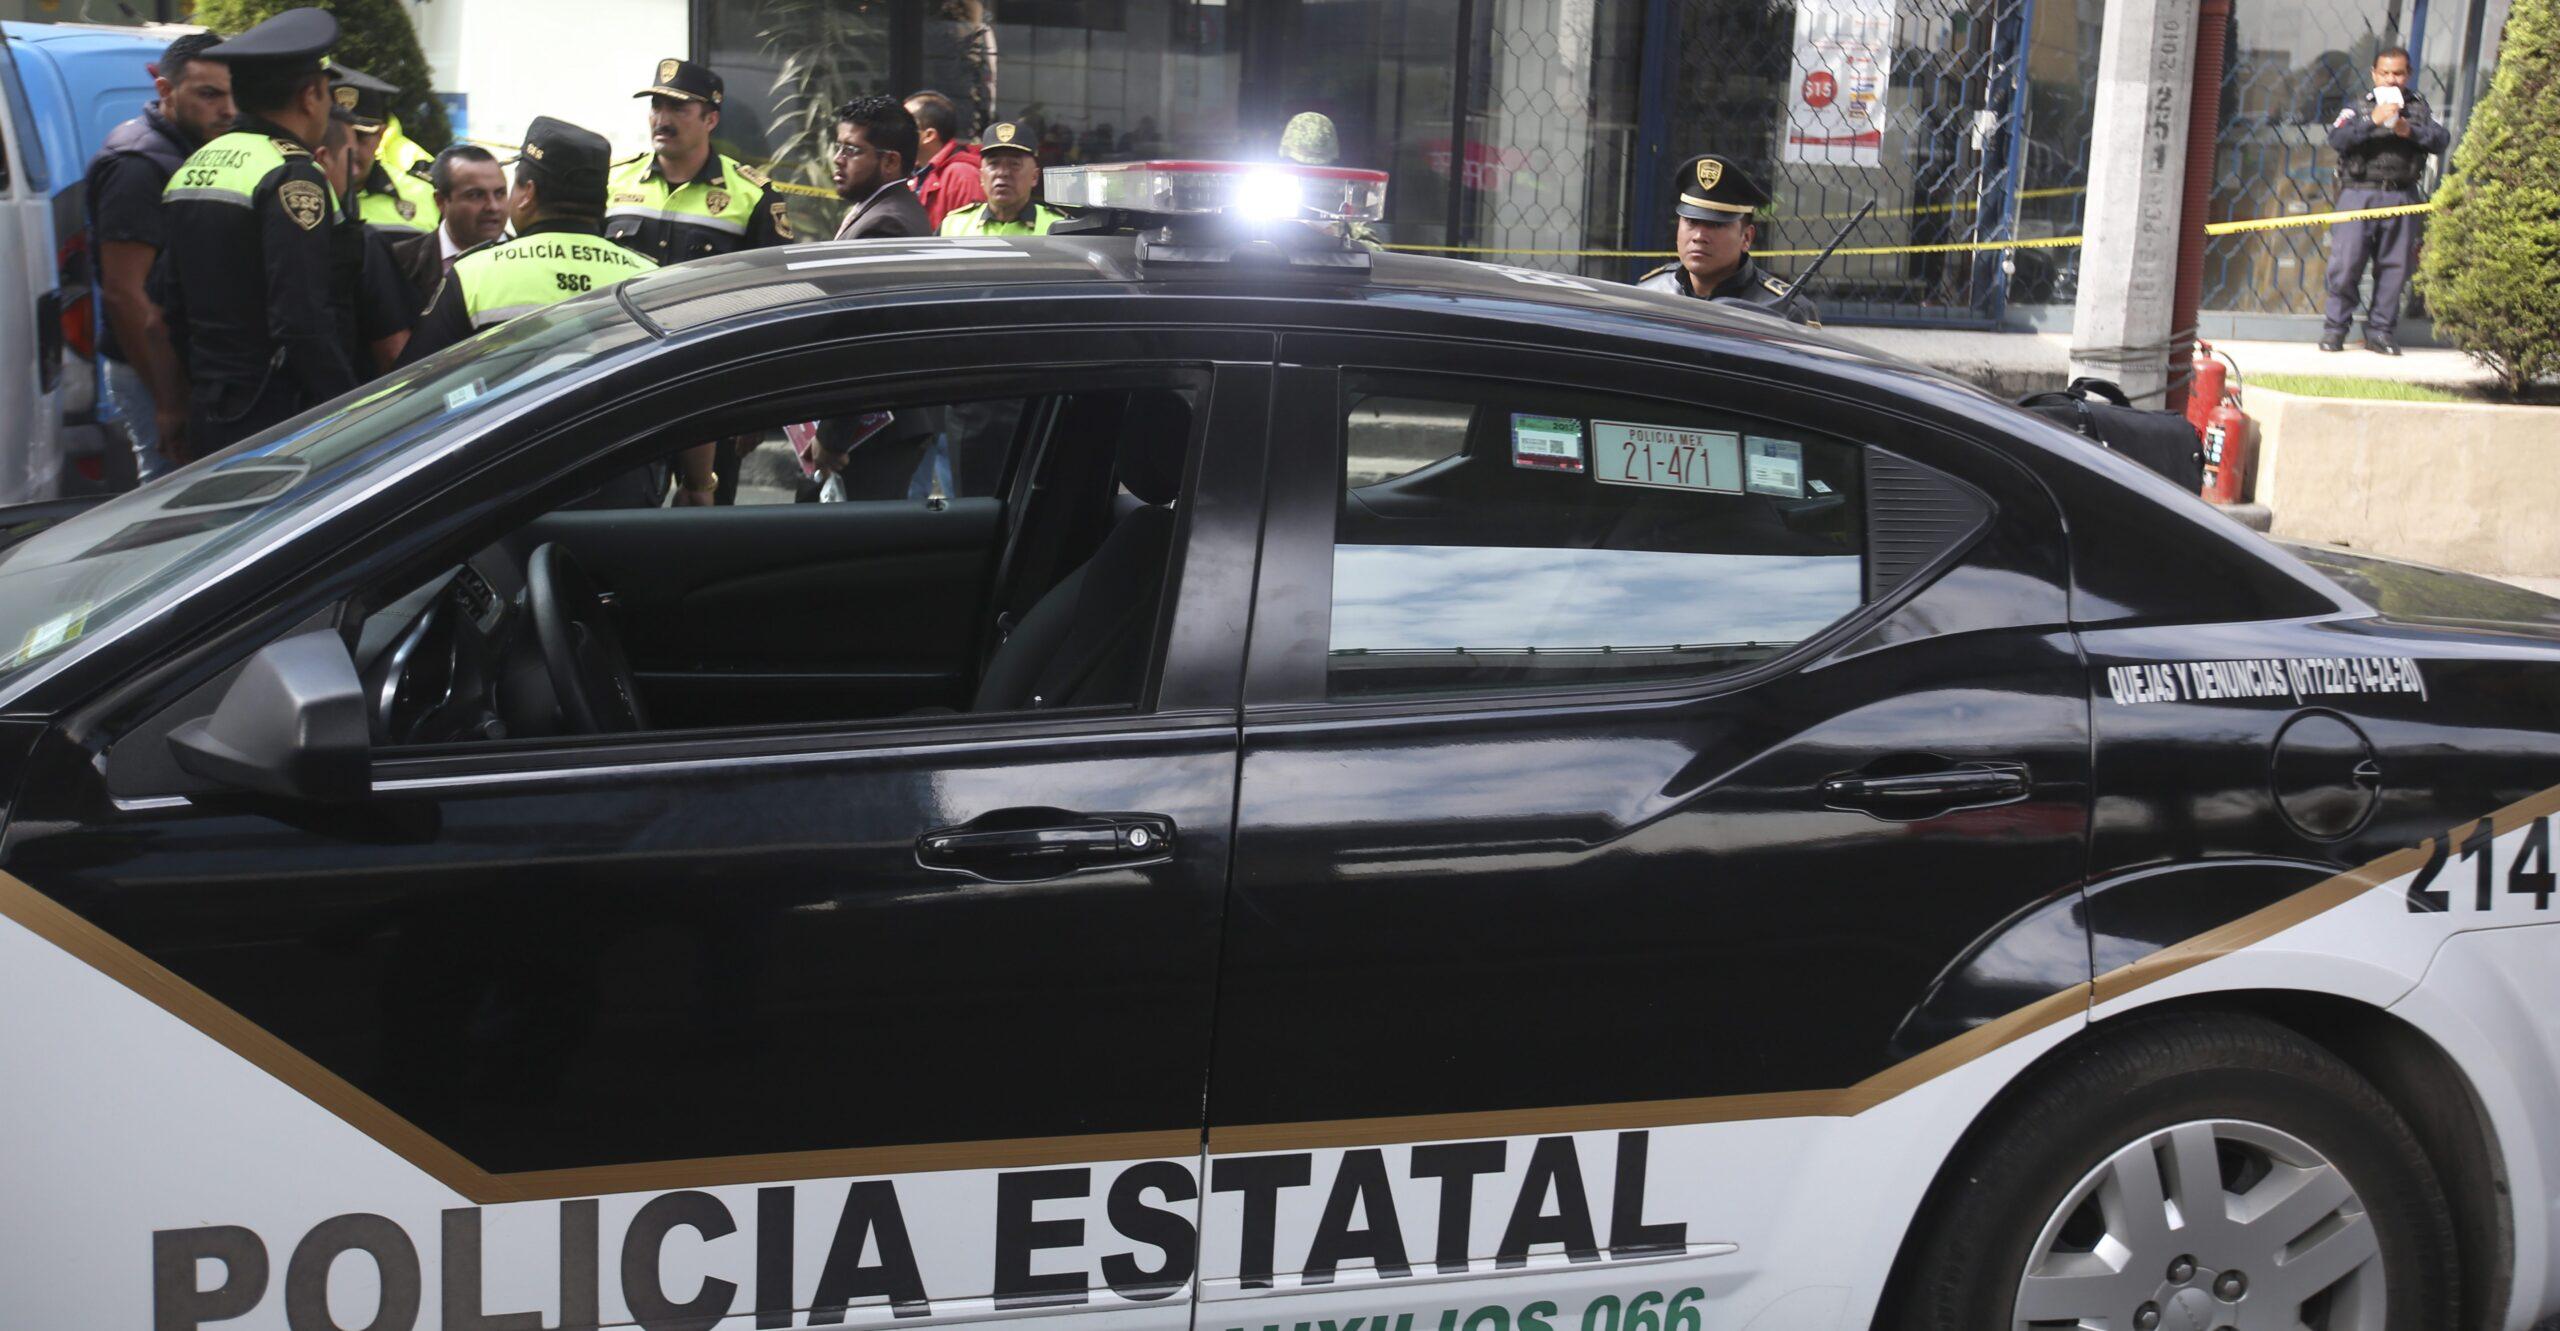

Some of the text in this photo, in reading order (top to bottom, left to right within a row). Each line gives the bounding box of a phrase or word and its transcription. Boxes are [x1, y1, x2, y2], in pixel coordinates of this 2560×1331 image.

[183, 169, 218, 186] SSC
[494, 240, 641, 269] POLICÍA ESTATAL
[556, 272, 592, 292] SSC
[1629, 429, 1704, 447] POLICIA MEX
[1623, 441, 1710, 486] 21-471
[2107, 663, 2178, 706] QUEJAS
[2172, 662, 2192, 700] Y
[2189, 659, 2289, 700] DENUNCIAS
[2406, 816, 2557, 914] 214
[153, 1130, 1688, 1331] POLICIA ESTATAL
[1582, 1286, 1705, 1331] 066
